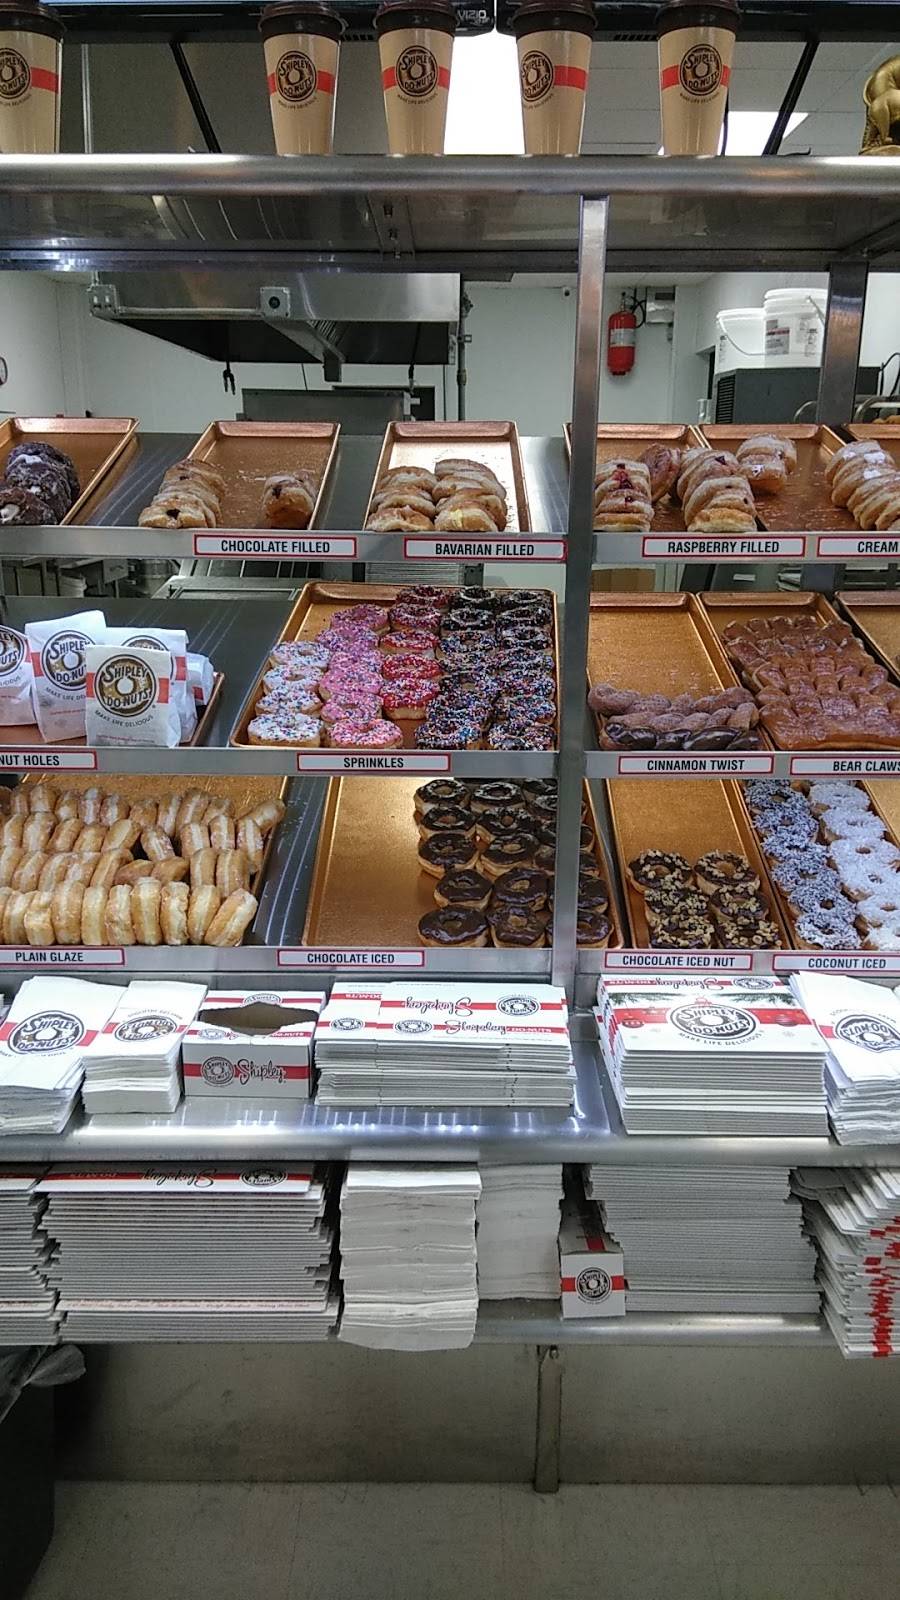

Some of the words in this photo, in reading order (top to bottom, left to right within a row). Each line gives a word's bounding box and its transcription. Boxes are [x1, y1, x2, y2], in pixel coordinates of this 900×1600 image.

[457, 10, 487, 20] VIZIO
[401, 55, 432, 70] SHIPLEY
[686, 53, 717, 69] SHIPLEY
[279, 60, 309, 76] SHIPLEY
[221, 540, 288, 552] CHOCOLATE
[292, 541, 330, 553] FILLED
[435, 543, 492, 555] BAVARIAN
[496, 544, 534, 556] FILLED
[668, 541, 737, 553] RASPBERRY
[741, 541, 779, 553] FILLED
[857, 541, 899, 553] CREAM
[102, 663, 147, 683] SHIPLEY
[24, 755, 60, 766] HOLES
[344, 757, 404, 768] SPRINKLES
[647, 760, 706, 771] CINNAMON
[711, 760, 745, 771] TWIST
[833, 761, 861, 771] BEAR
[15, 952, 46, 962] PLAIN
[50, 952, 83, 962] GLAZE
[307, 953, 368, 963] CHOCOLATE
[371, 954, 395, 964] ICED
[622, 955, 683, 966] CHOCOLATE
[686, 957, 710, 967] ICED
[713, 958, 735, 967] NUT
[808, 958, 859, 968] COCONUT
[862, 959, 886, 968] ICED
[679, 1008, 736, 1020] SHIPLEY
[23, 1019, 78, 1033] SHIPLEY
[238, 1059, 283, 1085] Shipley
